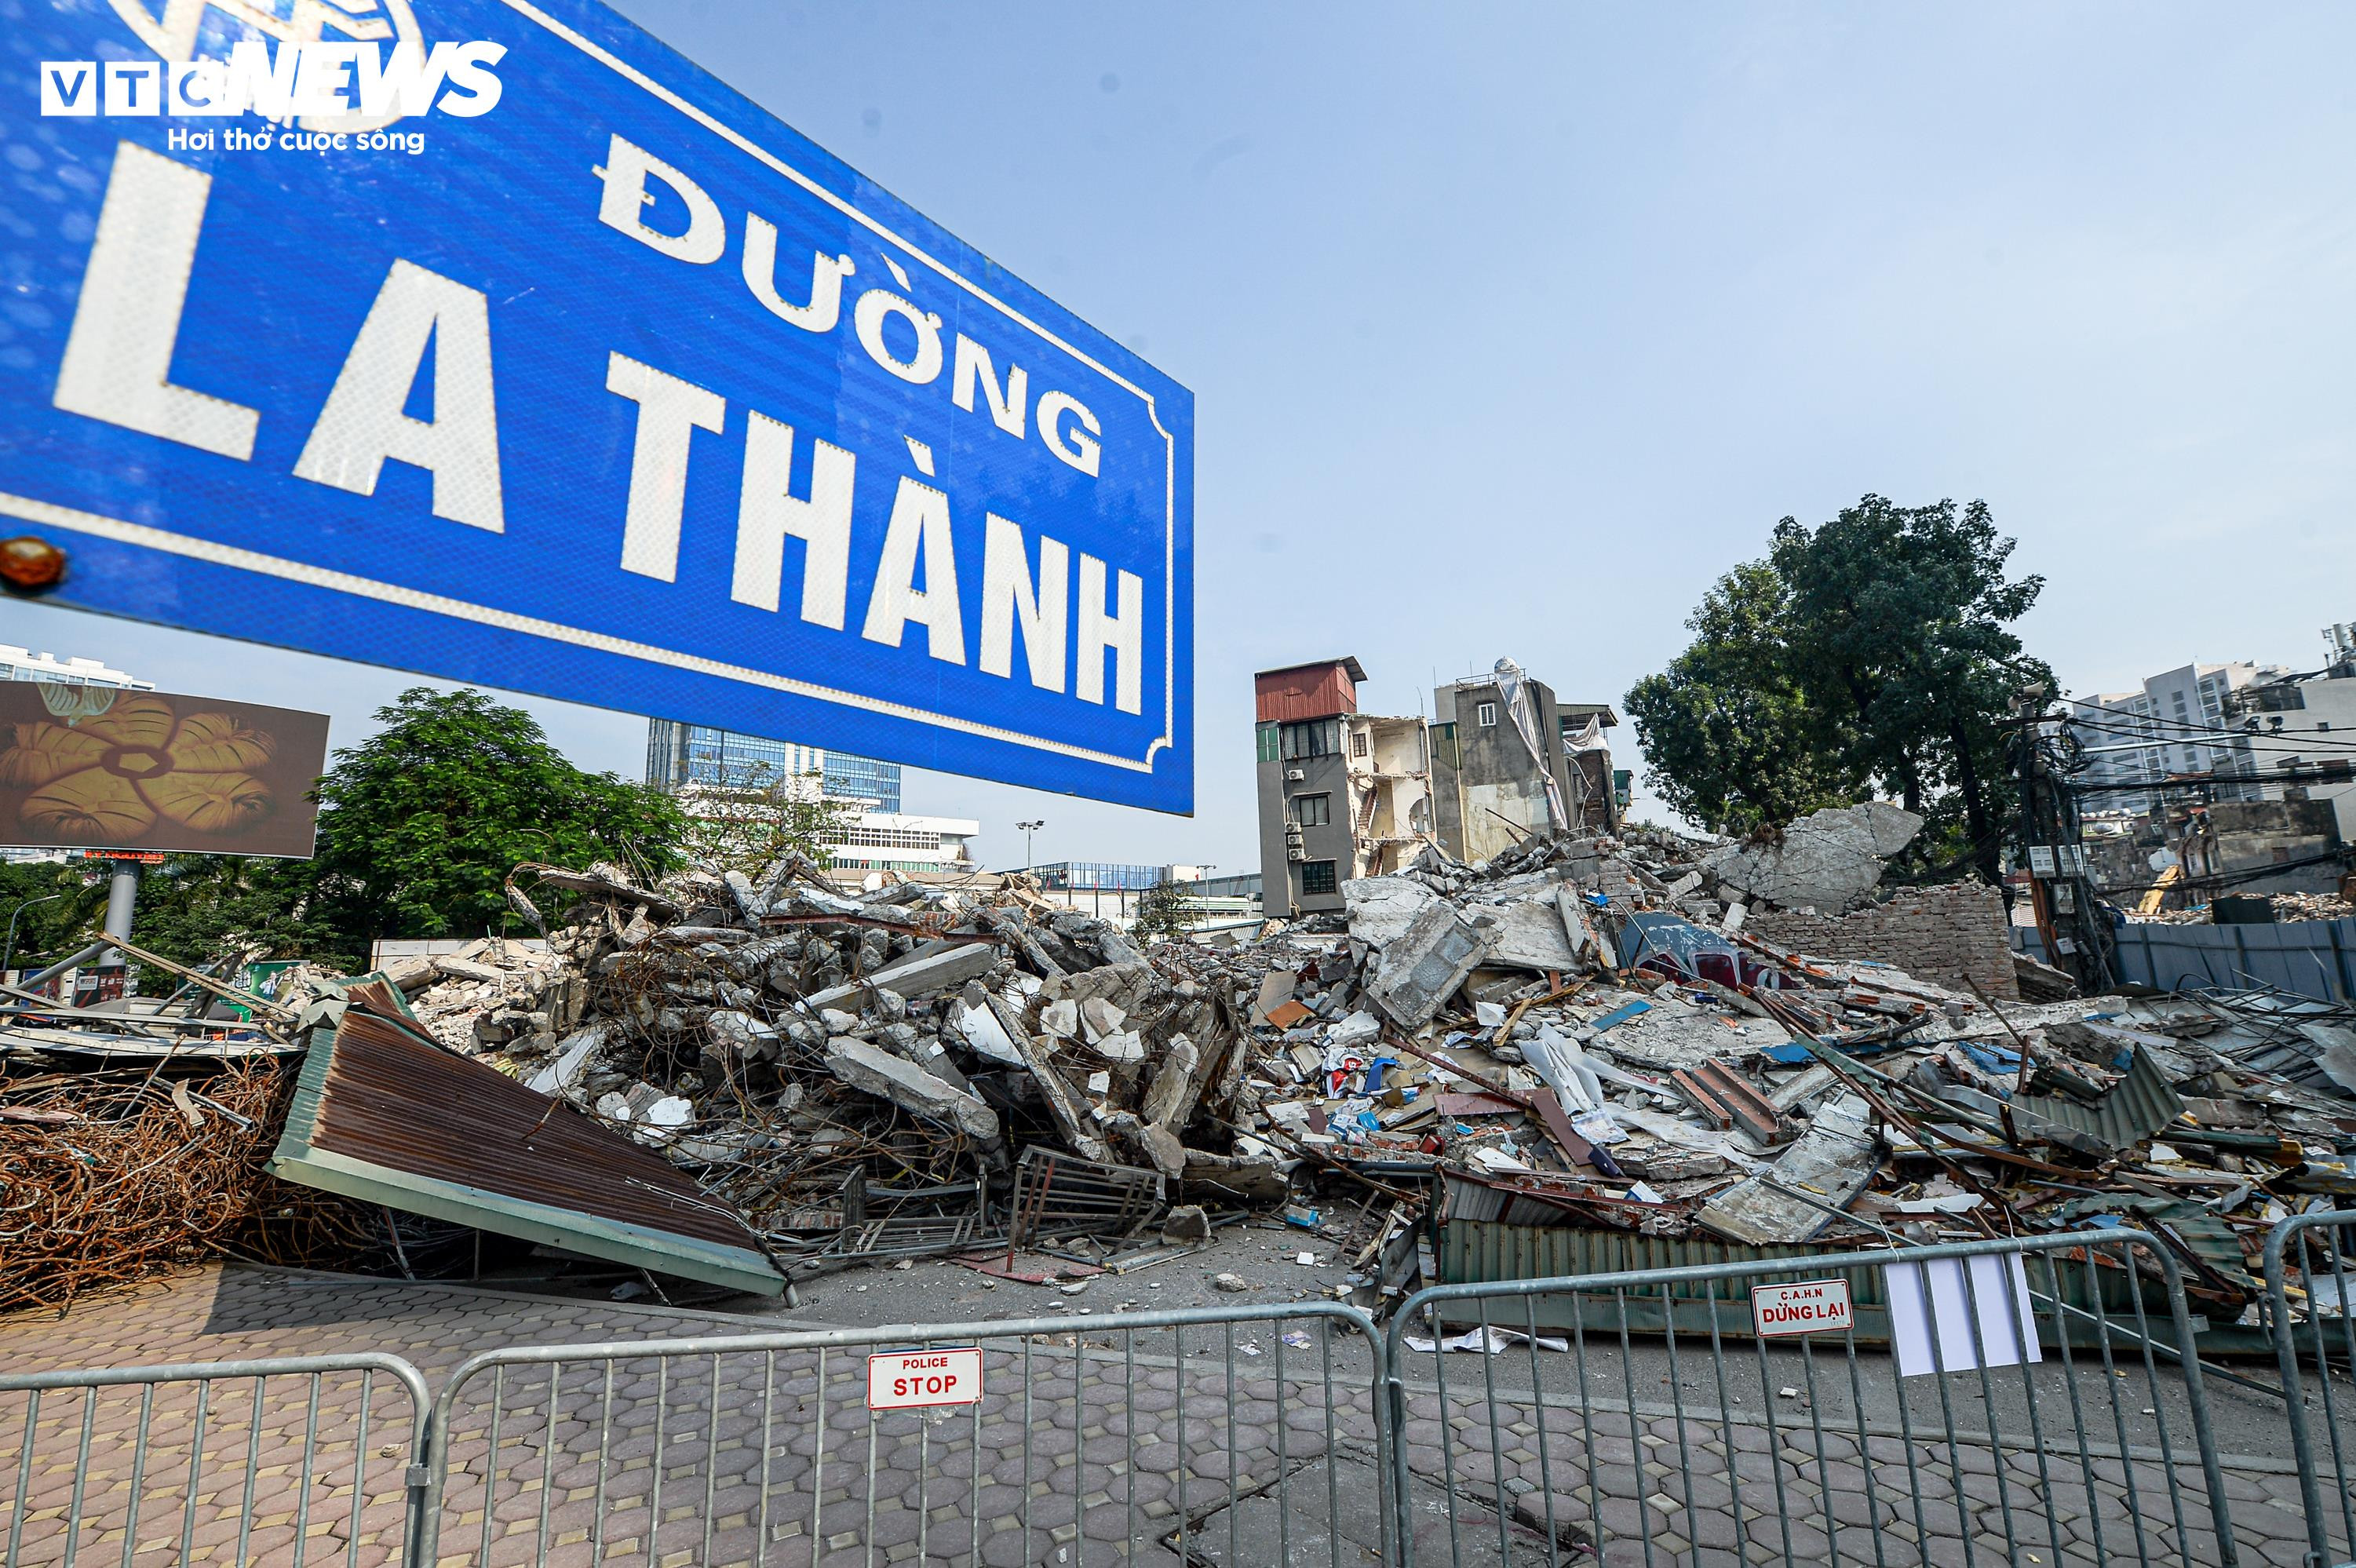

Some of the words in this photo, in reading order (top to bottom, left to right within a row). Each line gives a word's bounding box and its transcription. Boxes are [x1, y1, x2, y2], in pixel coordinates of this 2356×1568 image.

[593, 133, 1101, 477] ĐƯỜNG
[53, 140, 505, 534] LA
[606, 351, 1142, 715] THÀNH
[1781, 1288, 1823, 1300] C.A.H.N
[1763, 1303, 1813, 1323] DỪNG
[1816, 1302, 1845, 1320] LẠI
[903, 1357, 948, 1369] POLICE
[893, 1375, 957, 1396] STOP
